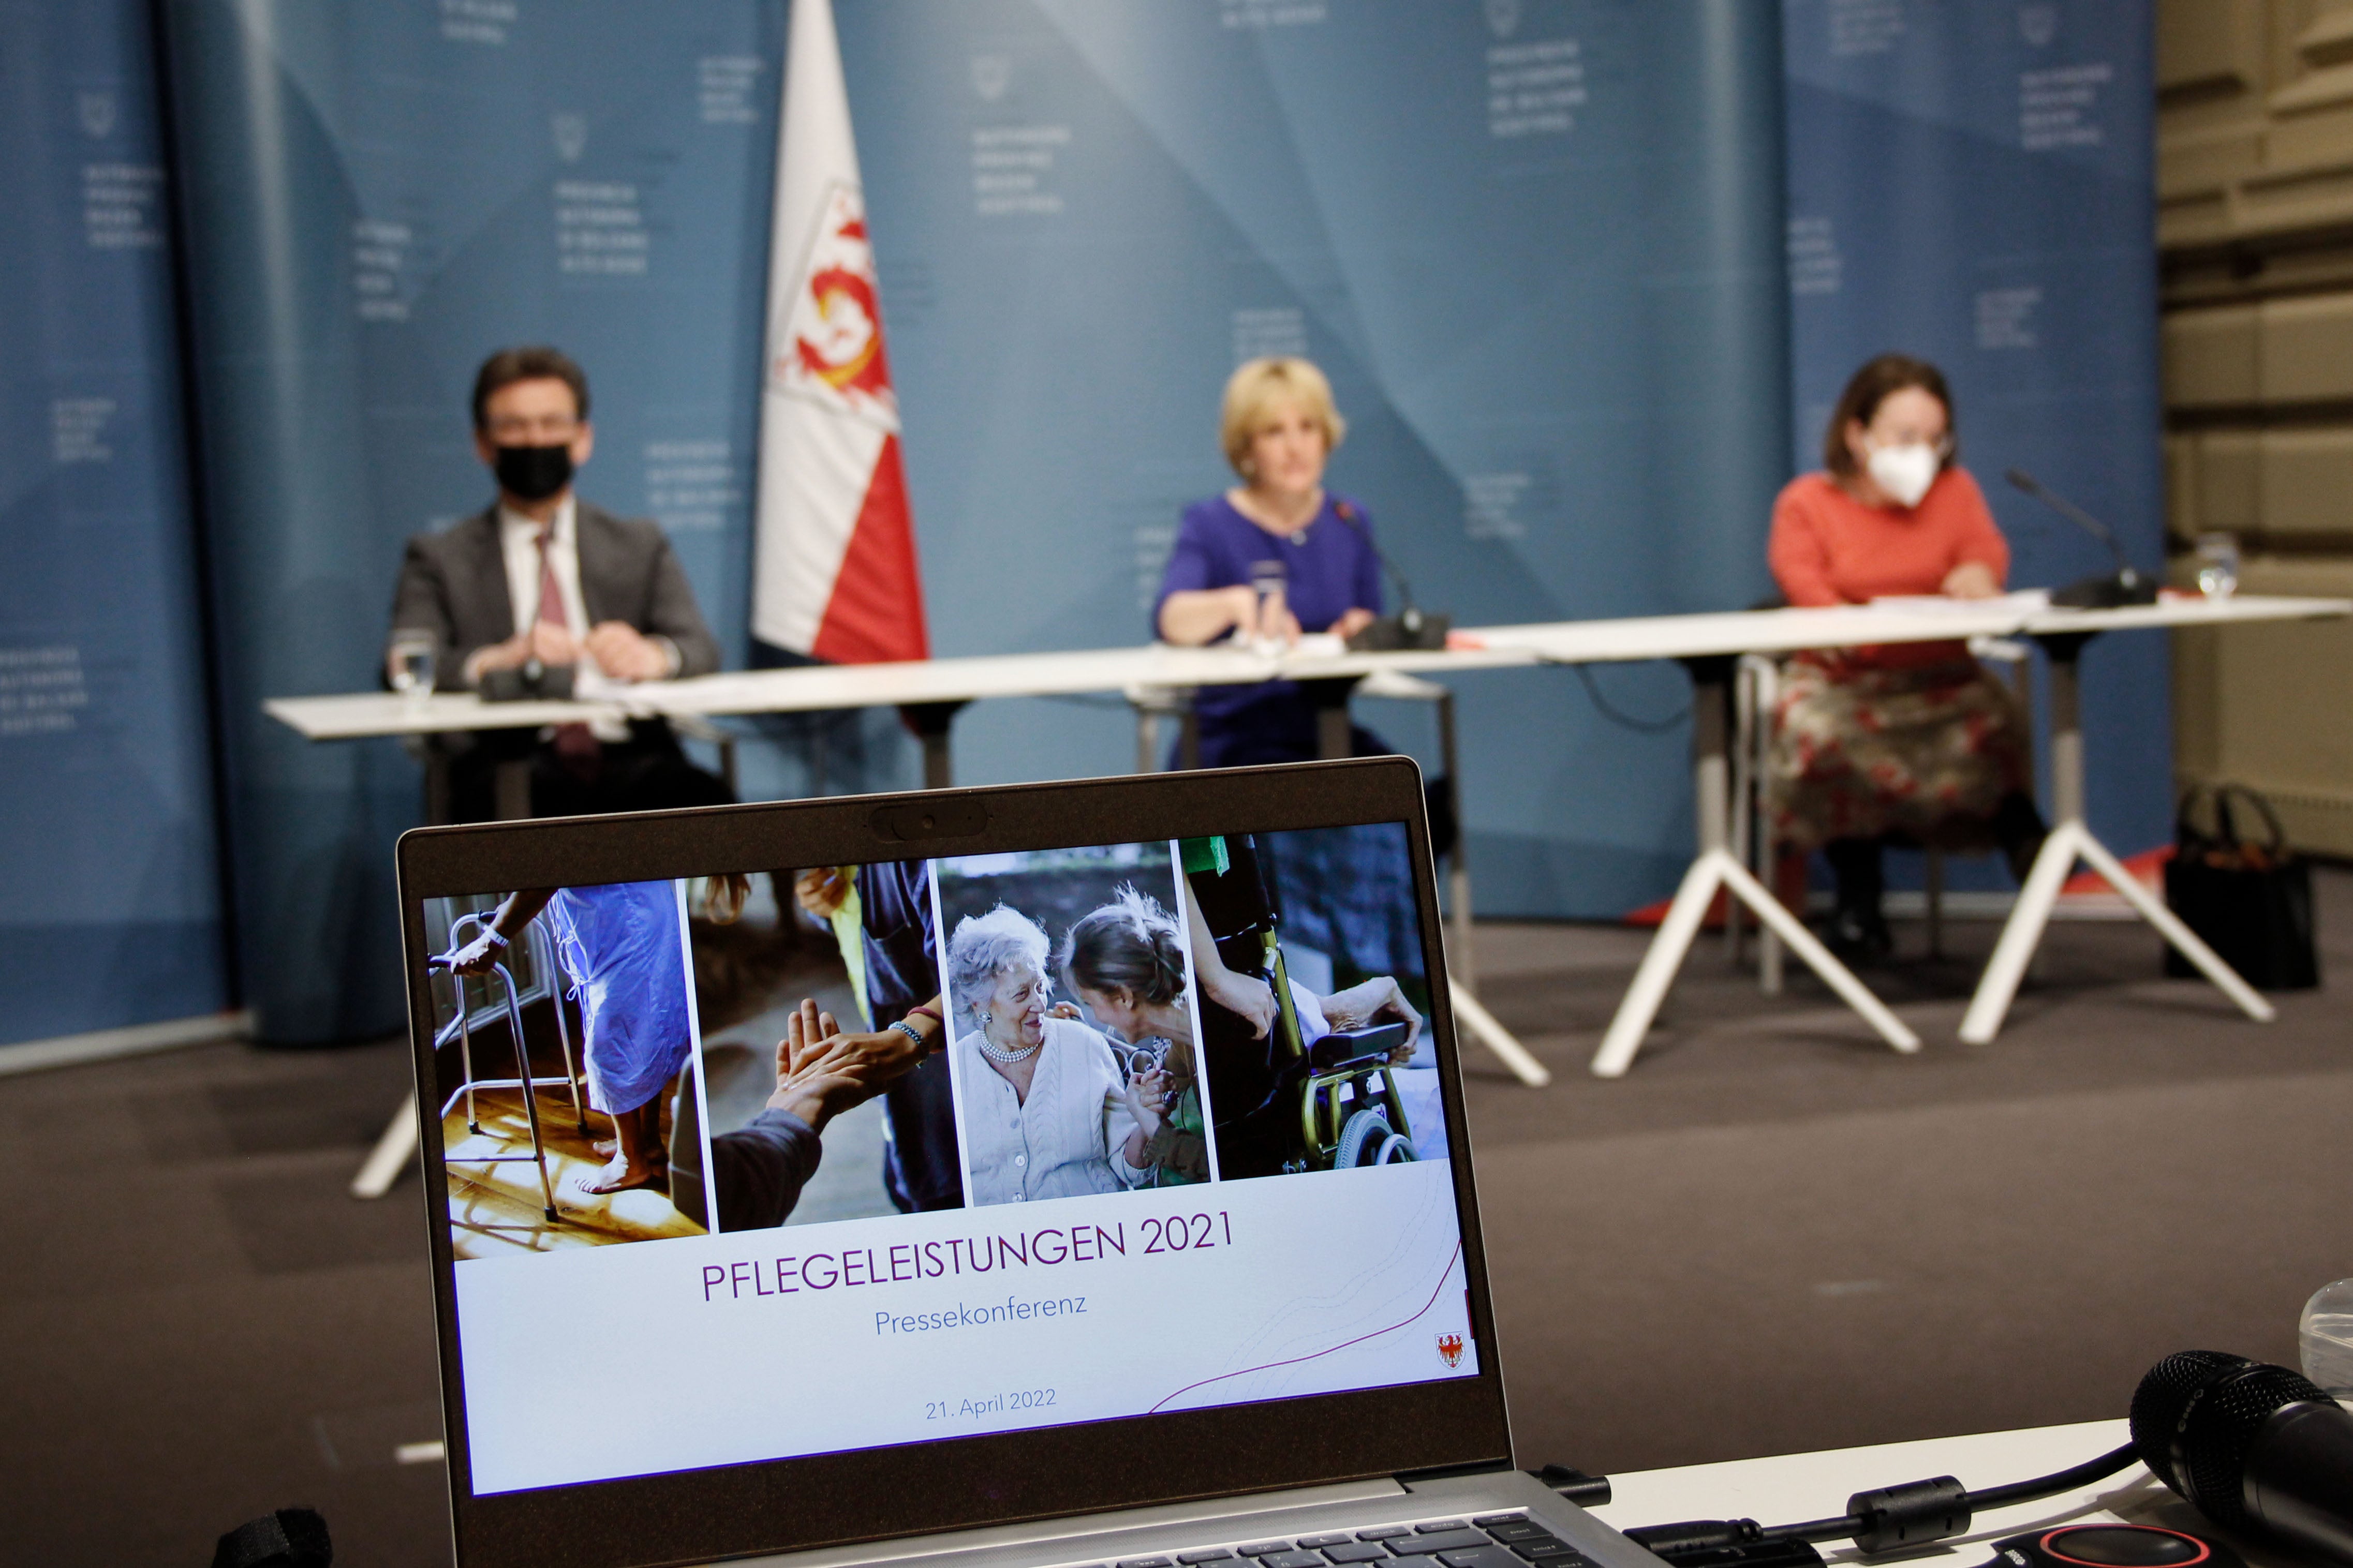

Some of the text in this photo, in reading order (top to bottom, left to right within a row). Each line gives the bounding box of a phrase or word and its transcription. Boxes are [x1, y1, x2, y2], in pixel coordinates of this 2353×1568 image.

[702, 1211, 1232, 1303] PFLEGELEISTUNGEN 2021
[875, 1295, 1088, 1336] Pressekonferenz
[925, 1388, 1057, 1420] 21. April 2022
